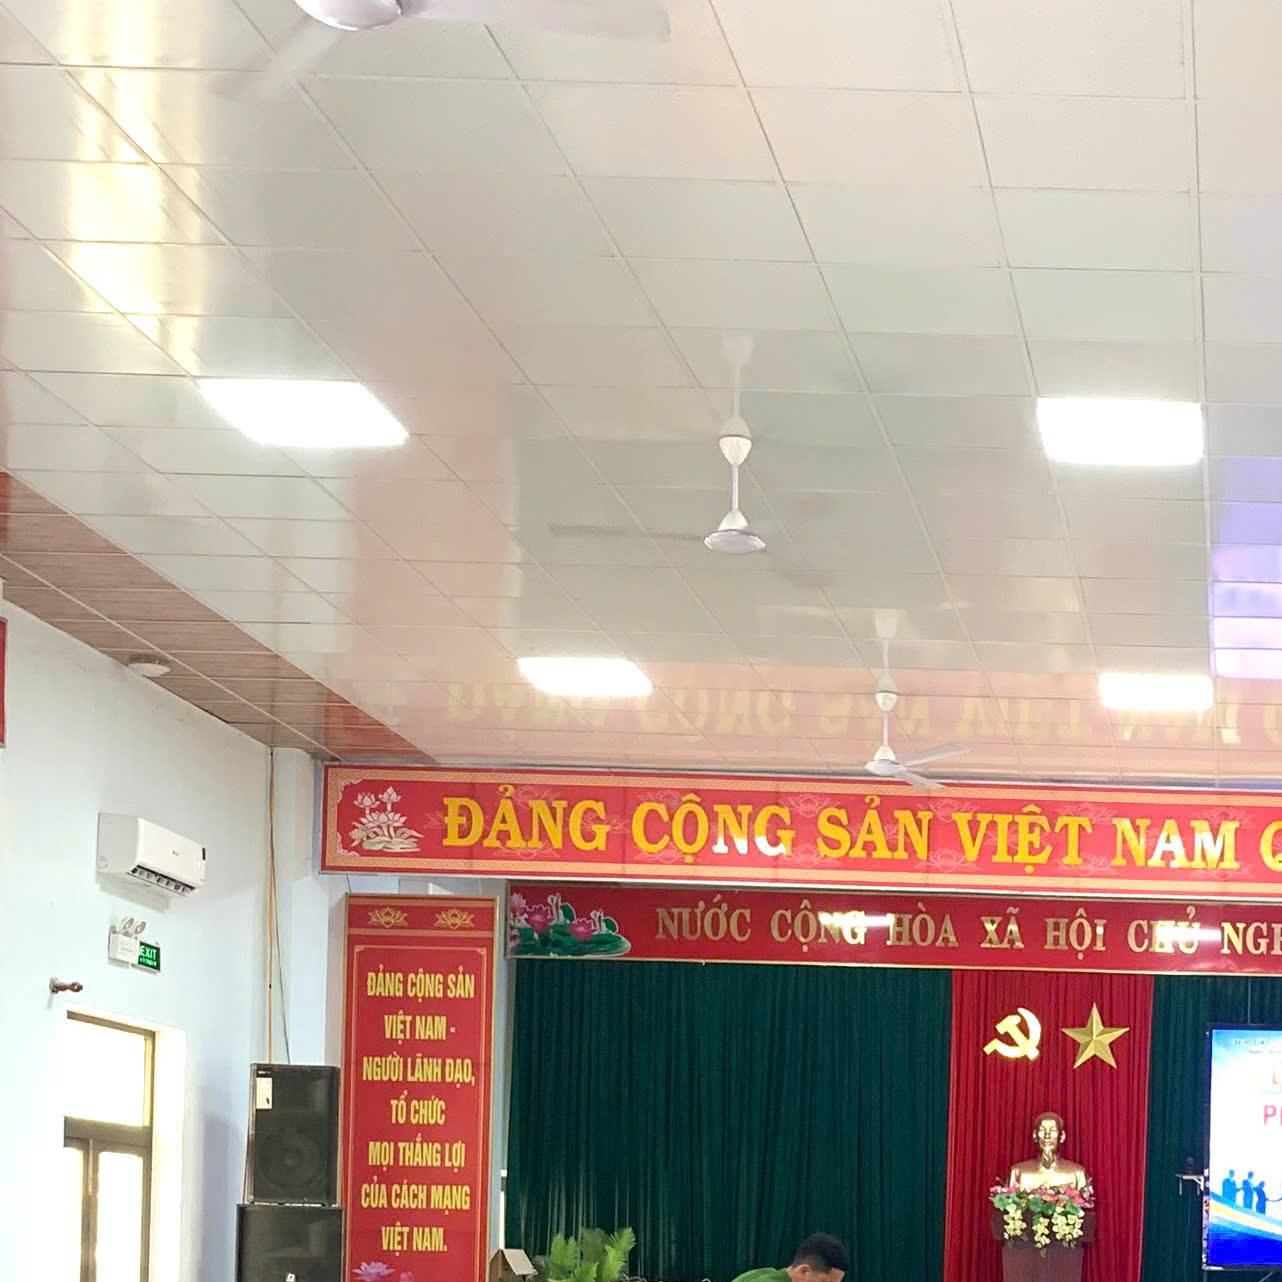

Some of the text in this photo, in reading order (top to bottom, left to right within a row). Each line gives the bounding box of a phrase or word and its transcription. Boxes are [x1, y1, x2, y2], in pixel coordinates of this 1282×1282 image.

[442, 784, 610, 851] ĐẢNG
[631, 793, 795, 863] CỘNG
[816, 795, 933, 861] SẢN
[952, 804, 1093, 873] VIỆT
[1112, 818, 1241, 869] NAM
[656, 894, 751, 941] NƯỚC
[771, 899, 868, 953] CỘNG
[888, 902, 958, 947] HÒA
[980, 907, 1025, 949] XÃ
[1044, 907, 1107, 960] HỘI
[1127, 906, 1201, 954] CHỦ
[367, 964, 475, 1003] ĐẢNG CỘNG SẢN
[384, 1010, 412, 1044] VIỆT
[416, 1015, 447, 1040] NAM
[363, 1051, 403, 1081] NGƯỜI
[407, 1053, 441, 1082] LÃNH
[390, 1089, 446, 1125] TỔ CHỨC
[368, 1133, 466, 1173] MỌI THẮNG LỢI
[361, 1175, 470, 1215] CỦA CÁCH MẠNG
[381, 1221, 448, 1256] VIỆT NAM.
